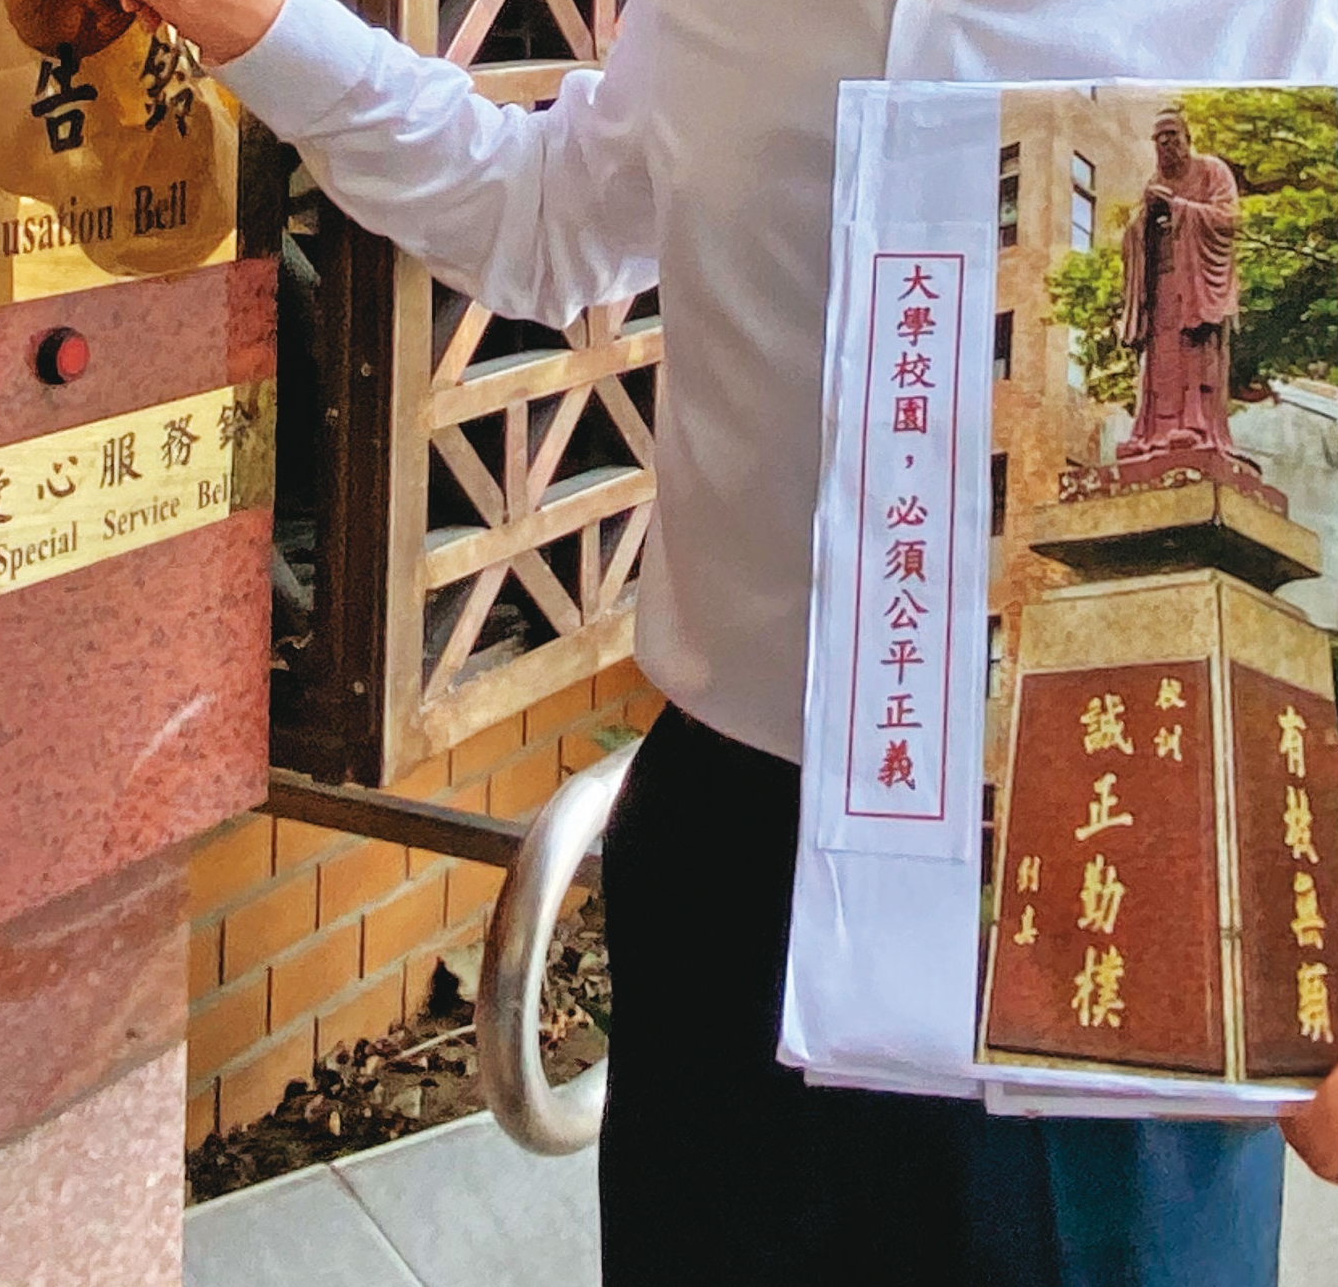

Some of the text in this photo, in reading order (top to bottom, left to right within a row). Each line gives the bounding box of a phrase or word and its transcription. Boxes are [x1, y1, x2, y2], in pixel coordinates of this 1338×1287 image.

[133, 180, 187, 236] Bell
[102, 495, 181, 542] Service
[197, 473, 233, 510] Bel
[876, 264, 940, 791] 大學校園，必須公平正義
